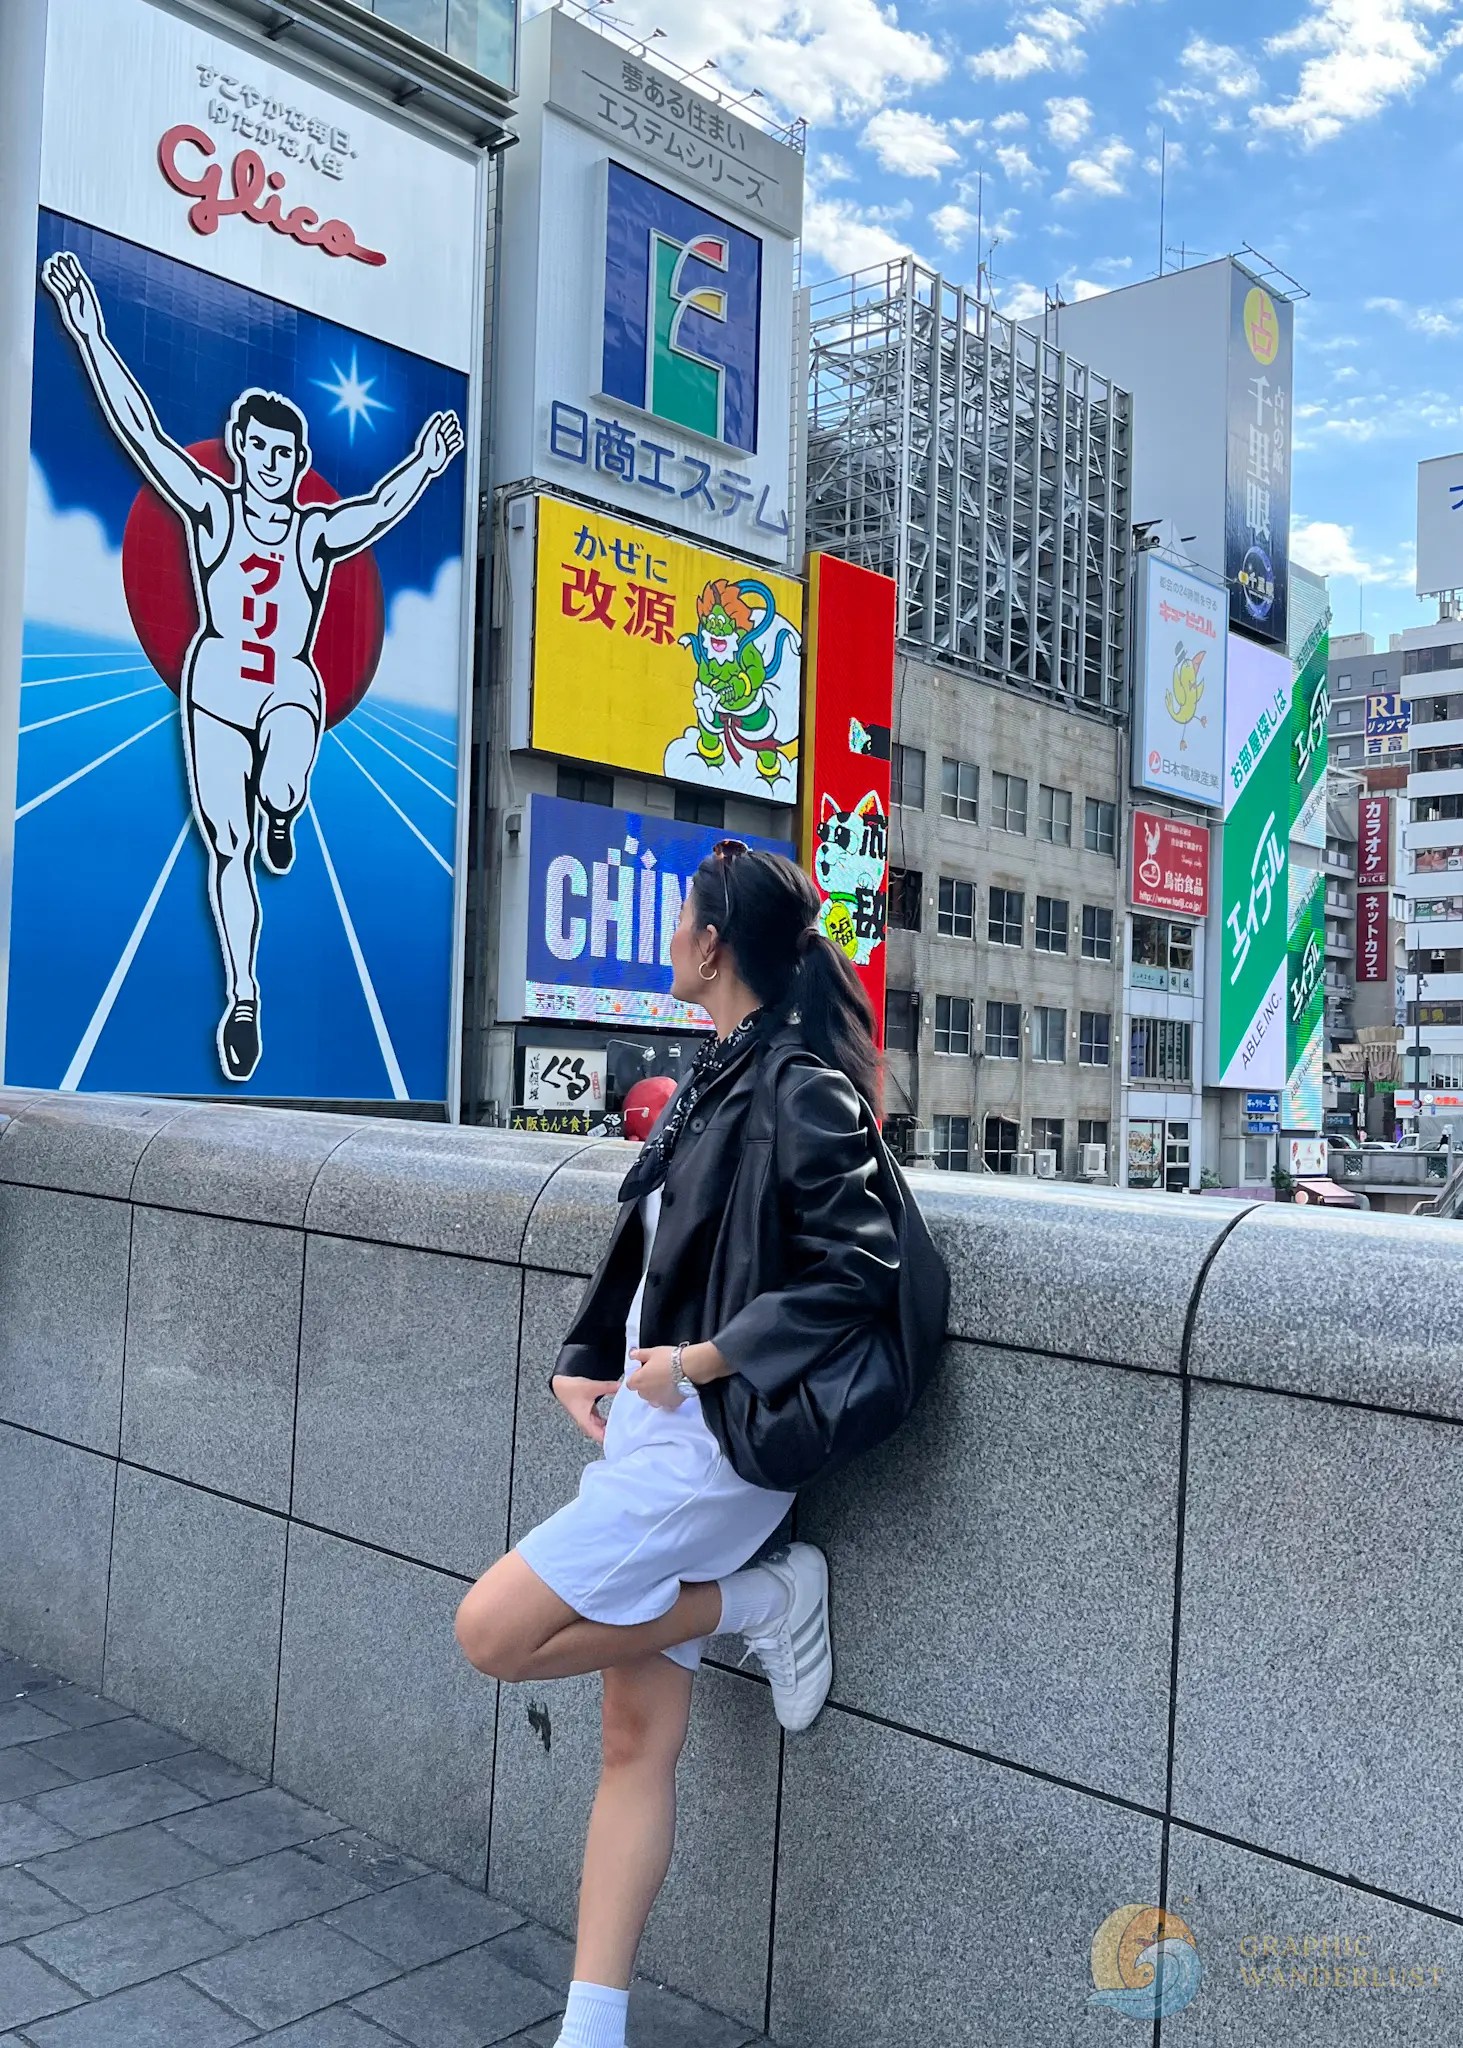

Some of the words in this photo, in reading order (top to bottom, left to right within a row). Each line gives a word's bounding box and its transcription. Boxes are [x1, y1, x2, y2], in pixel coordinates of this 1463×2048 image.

[208, 98, 344, 181] ゆたかな人生
[621, 60, 745, 151] 夢ある住まい
[597, 93, 764, 207] エステムシリーズ
[159, 124, 387, 267] Glico
[1250, 291, 1273, 358] 占
[550, 400, 789, 536] 日商エステム
[1246, 374, 1272, 541] 千里眼
[573, 524, 669, 584] かぜに
[239, 551, 285, 685] グリコ
[561, 562, 677, 645] 改源
[1230, 687, 1288, 790] お部屋探しは
[1294, 673, 1332, 784] エイブル
[1368, 694, 1411, 719] RI
[1162, 758, 1220, 789] 日本電機産業
[1365, 801, 1382, 871] カラオケ
[1226, 811, 1286, 985] エイブル
[1364, 895, 1379, 978] ネットカフェ
[1290, 930, 1321, 1022] エイブル
[540, 1055, 591, 1101] くくる
[512, 1114, 594, 1132] 大阪もんを食す
[608, 1126, 622, 1137] 2F
